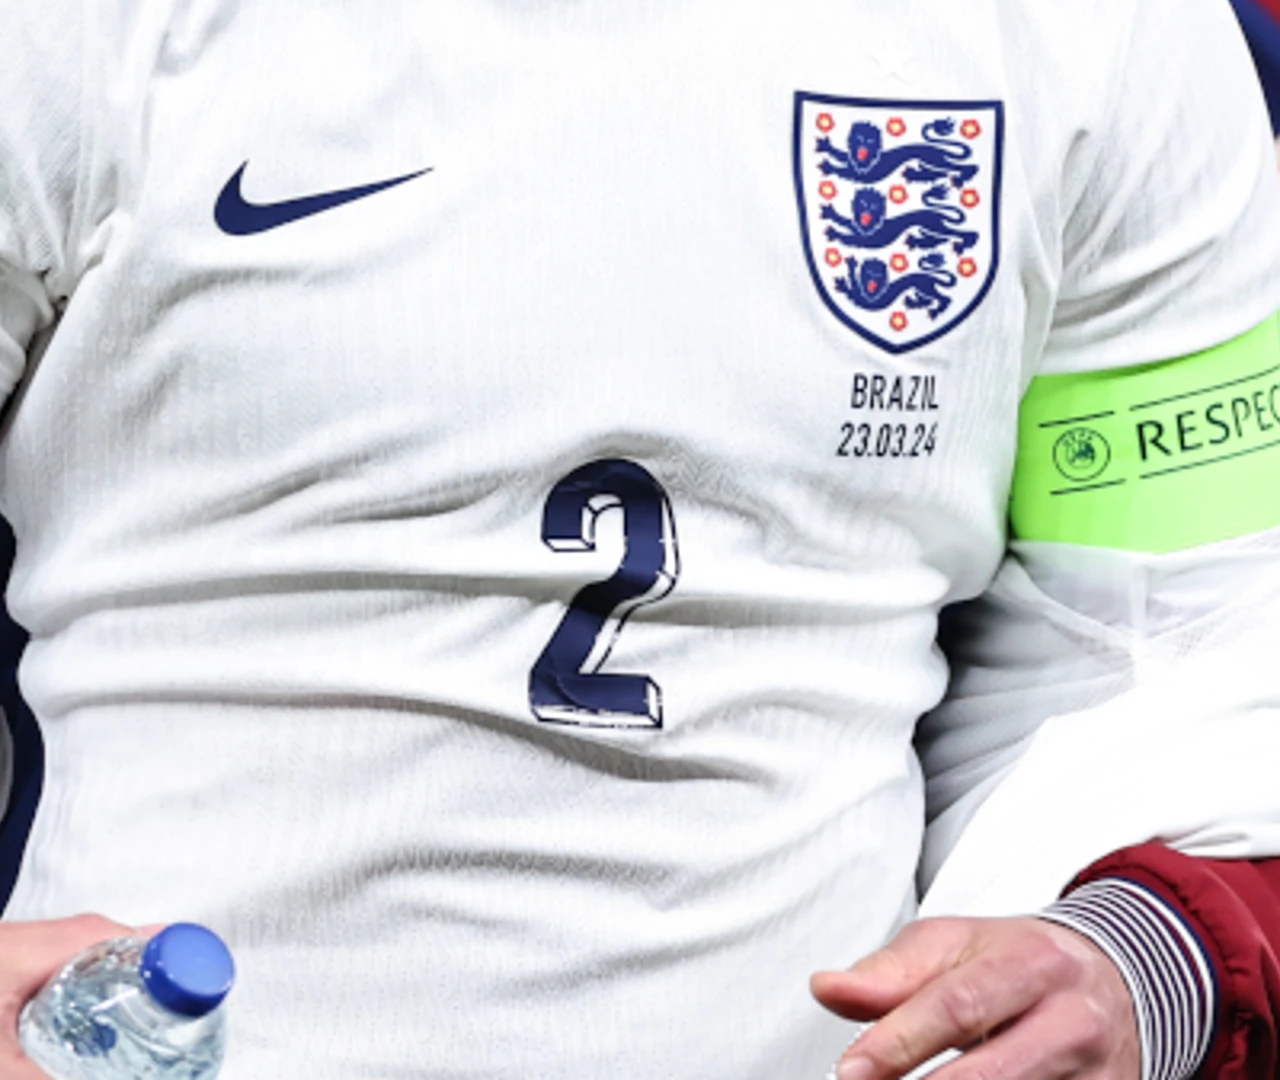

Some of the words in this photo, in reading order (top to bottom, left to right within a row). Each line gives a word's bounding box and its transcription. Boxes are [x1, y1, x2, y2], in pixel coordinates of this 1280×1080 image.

[851, 373, 938, 410] BRAZIL
[836, 421, 938, 457] 23.03.24
[528, 457, 680, 728] 2
